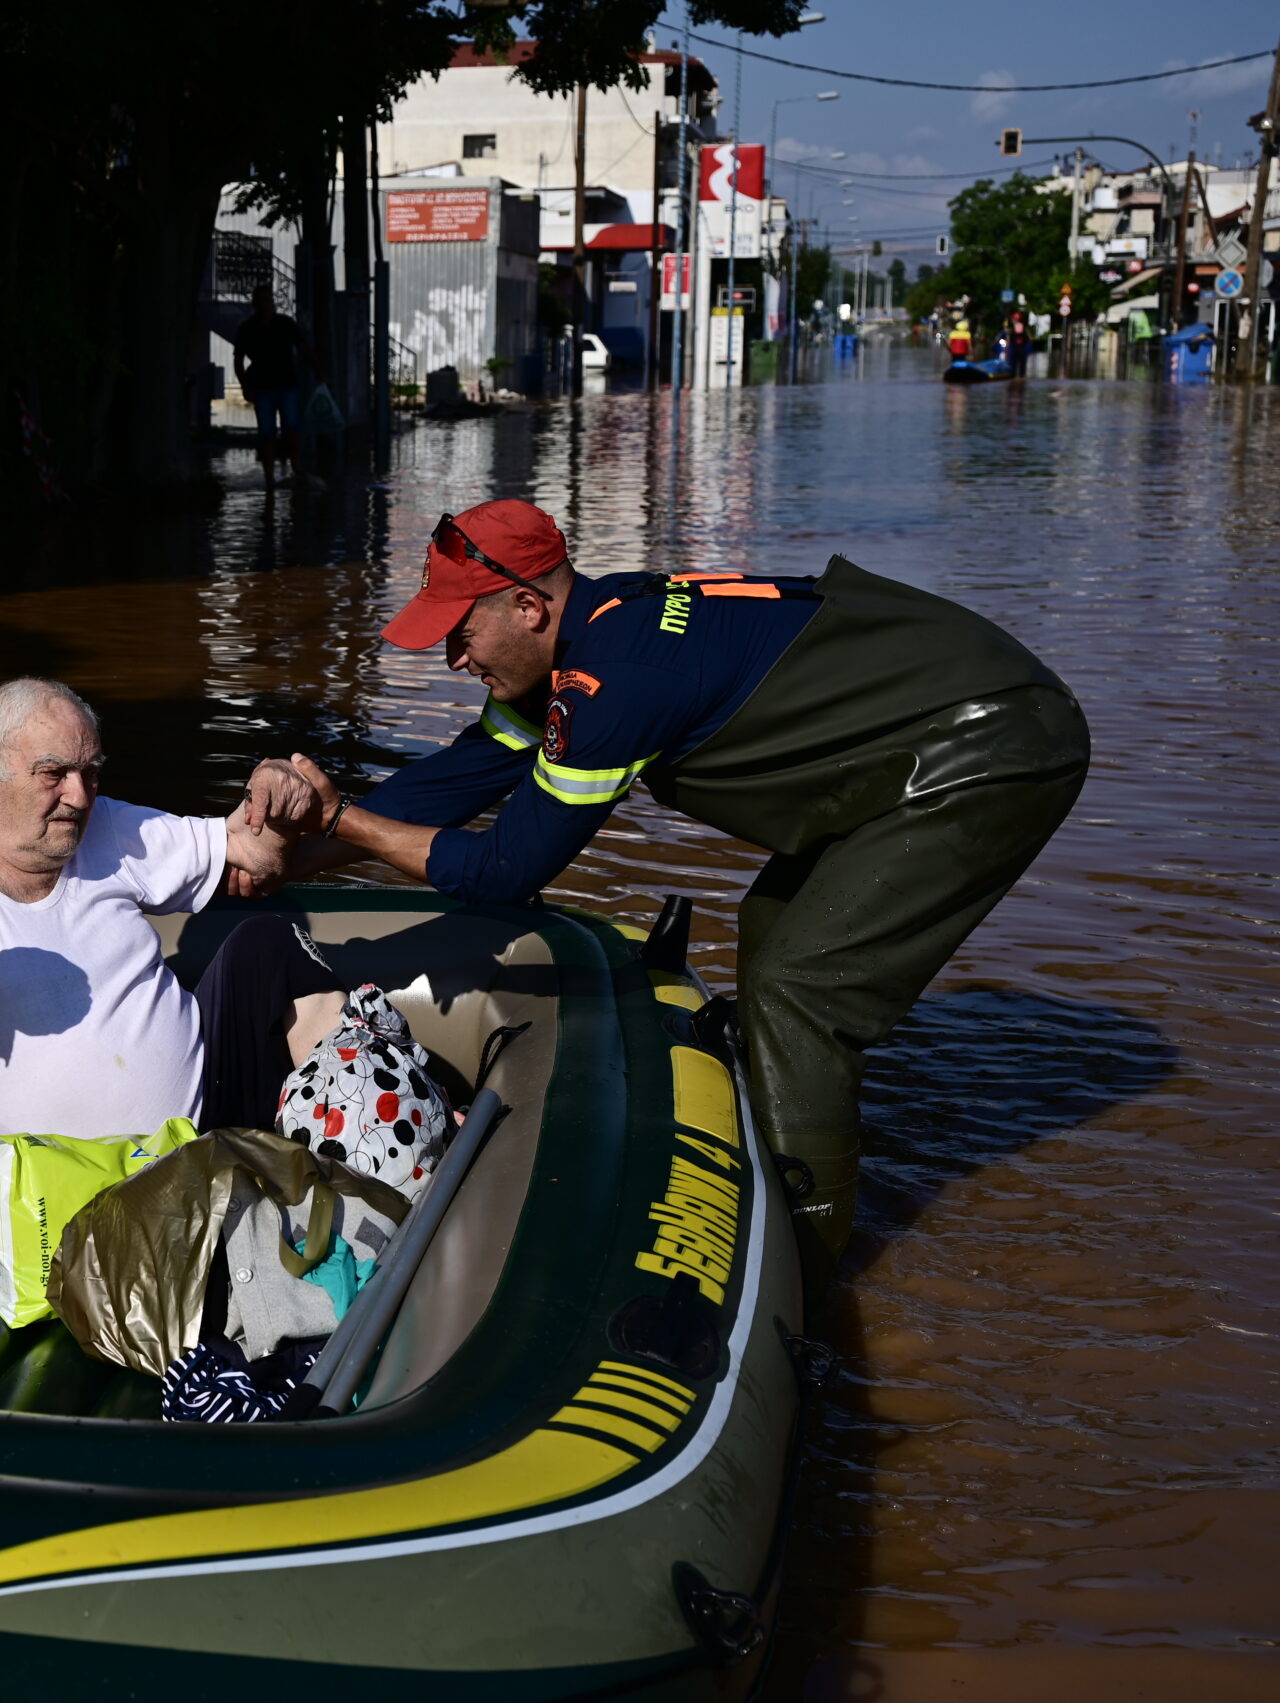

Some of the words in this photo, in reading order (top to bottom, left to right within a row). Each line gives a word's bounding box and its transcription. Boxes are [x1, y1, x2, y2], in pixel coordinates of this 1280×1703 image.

[675, 1133, 741, 1170] 4
[792, 1203, 831, 1214] DUNLOP
[635, 1155, 740, 1306] SEAHAWK
